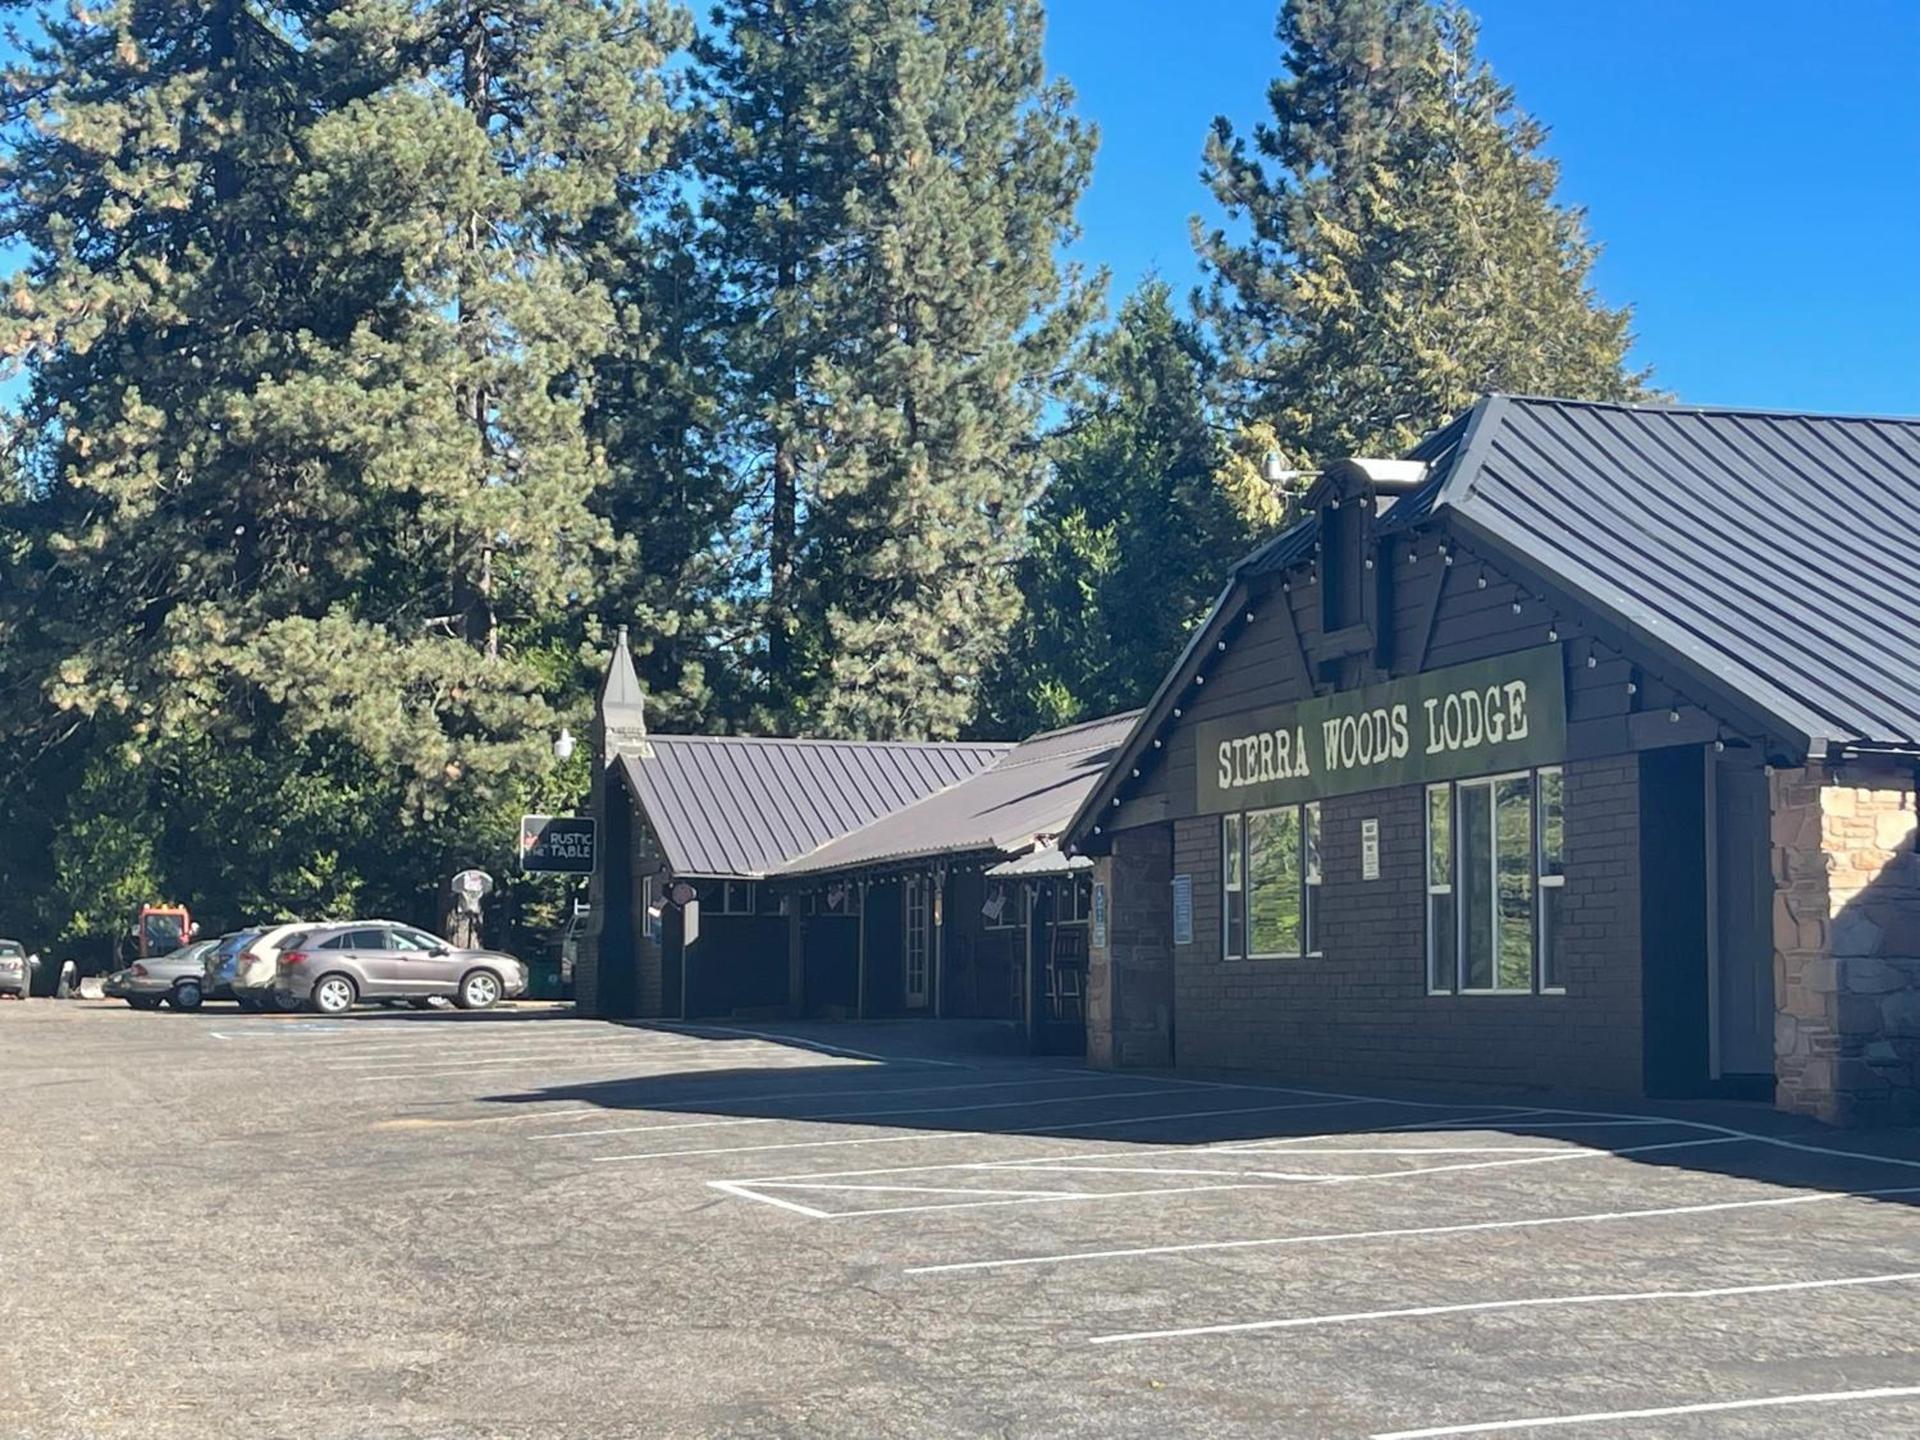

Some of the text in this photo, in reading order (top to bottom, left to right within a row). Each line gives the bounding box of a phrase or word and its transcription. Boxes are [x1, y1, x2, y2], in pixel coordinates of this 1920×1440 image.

[1218, 680, 1528, 789] SIERRA WOODS LODGE
[550, 832, 592, 845] RUSTIC
[551, 845, 591, 858] TABLE
